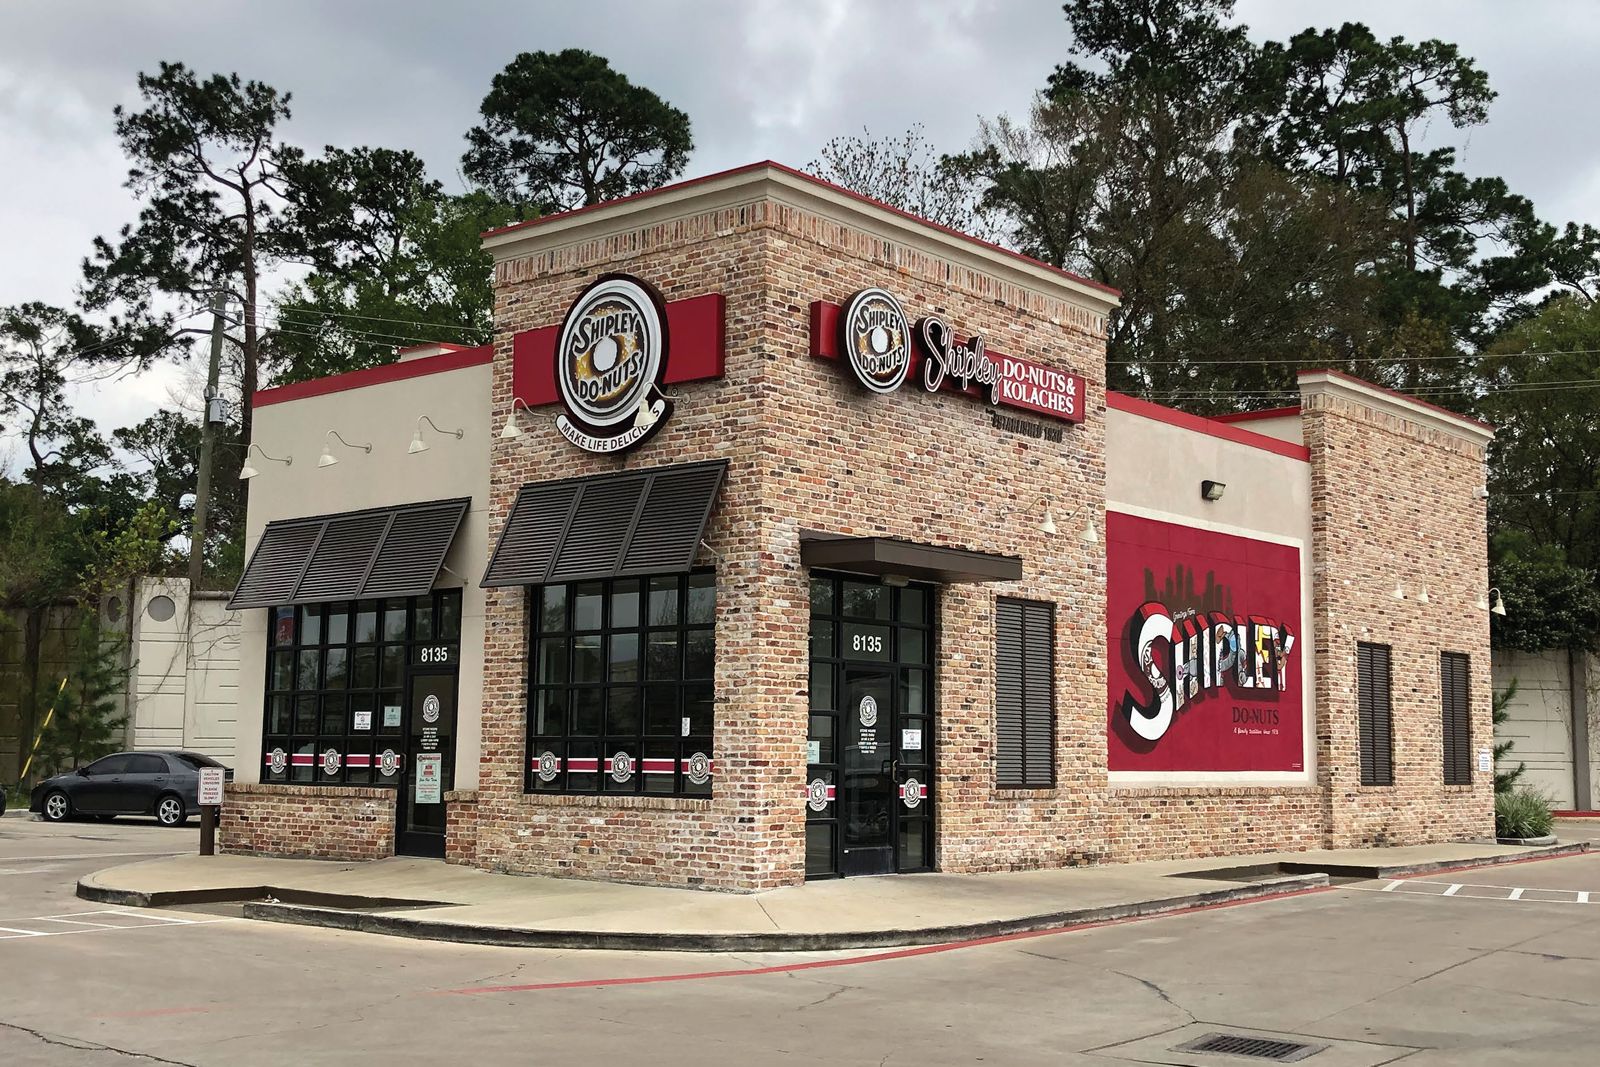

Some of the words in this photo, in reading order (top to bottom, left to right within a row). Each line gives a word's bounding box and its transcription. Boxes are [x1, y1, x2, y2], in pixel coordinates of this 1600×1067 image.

[573, 312, 638, 354] SHIPLEY
[856, 305, 901, 333] SHIPLEY
[579, 351, 642, 401] DO-NUTS
[861, 347, 904, 375] DO-NUTS
[921, 316, 1002, 405] Shipley
[1003, 380, 1074, 415] KOLACHES
[561, 422, 586, 447] MAKE
[587, 439, 608, 451] LIFE
[610, 407, 660, 450] DELICIOS
[421, 647, 448, 662] 8135
[853, 634, 882, 653] 8135
[1122, 602, 1296, 741] SHIPLEY
[1232, 707, 1279, 725] DO-NUTS
